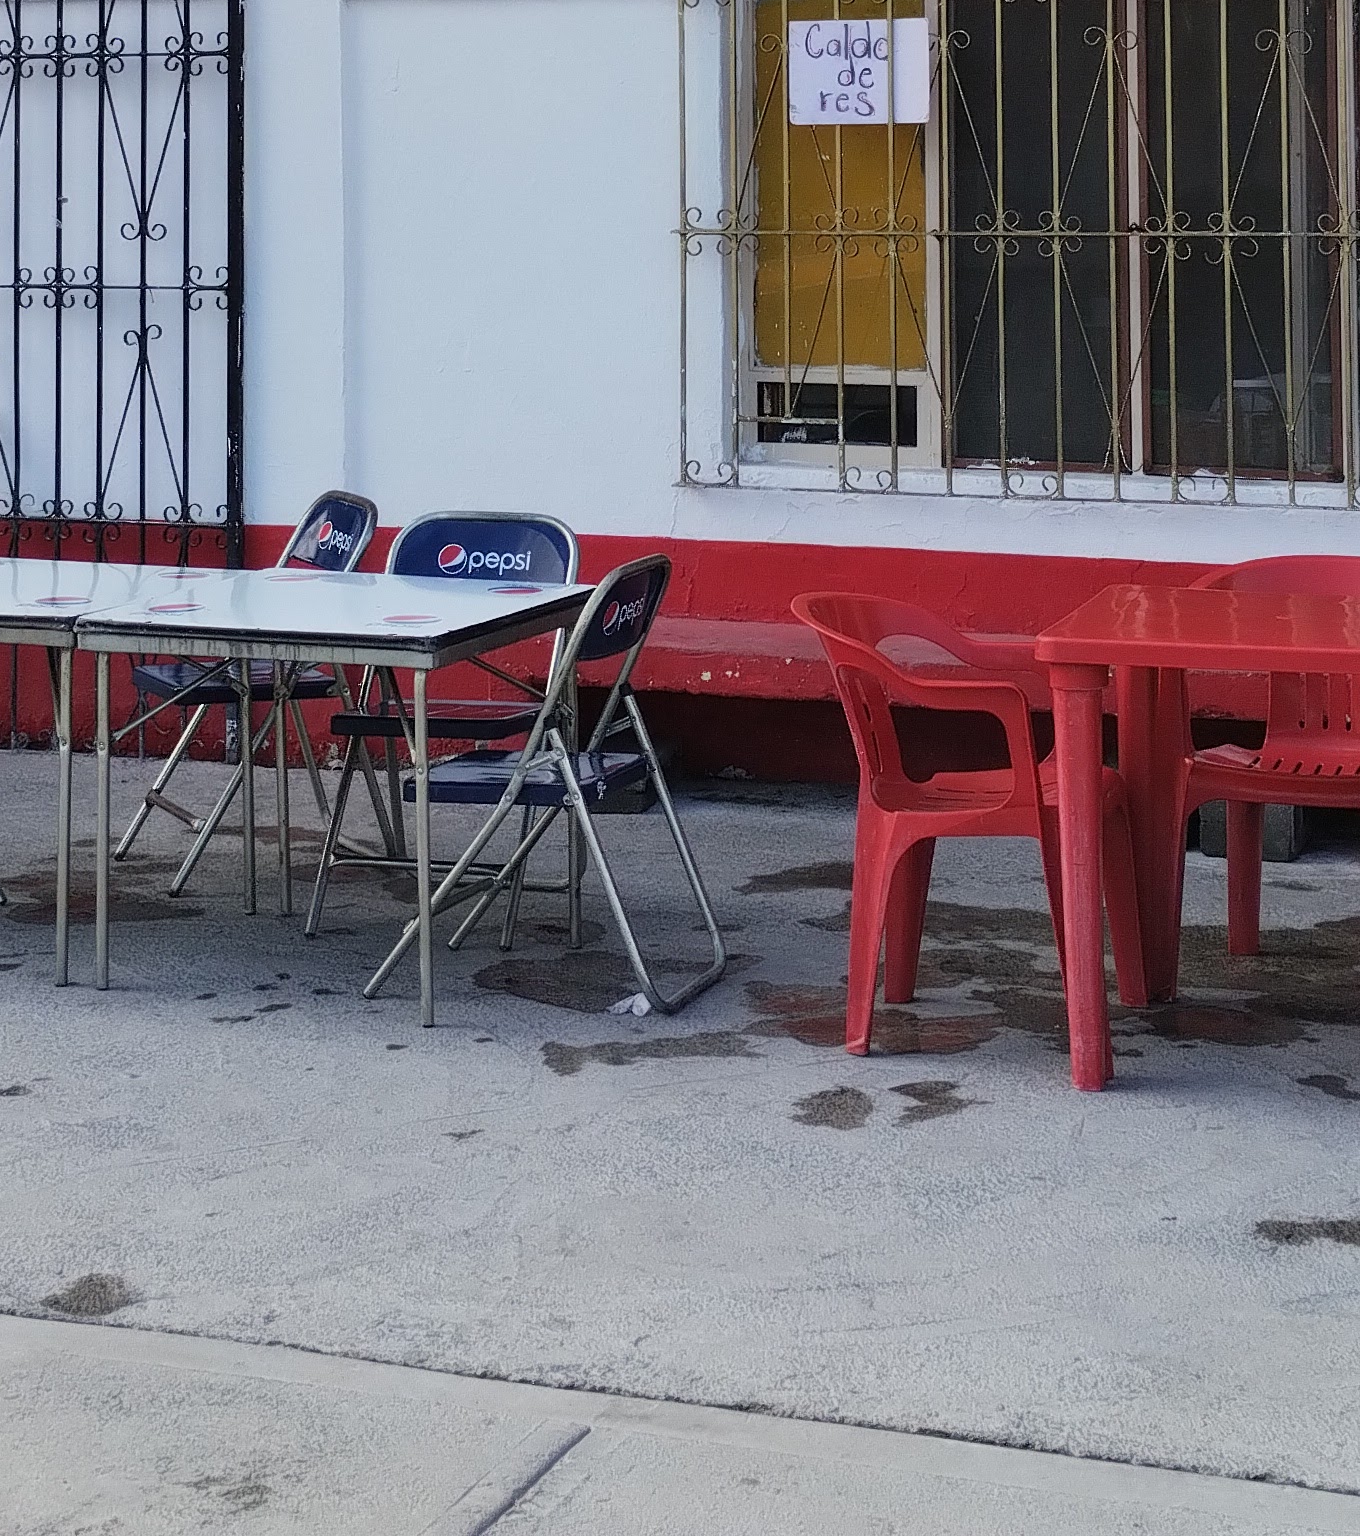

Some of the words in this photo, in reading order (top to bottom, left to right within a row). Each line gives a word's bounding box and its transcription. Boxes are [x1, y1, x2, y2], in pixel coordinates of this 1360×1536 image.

[837, 55, 875, 89] de
[819, 90, 876, 117] res
[329, 529, 354, 555] pepsi
[468, 551, 531, 575] pepsi
